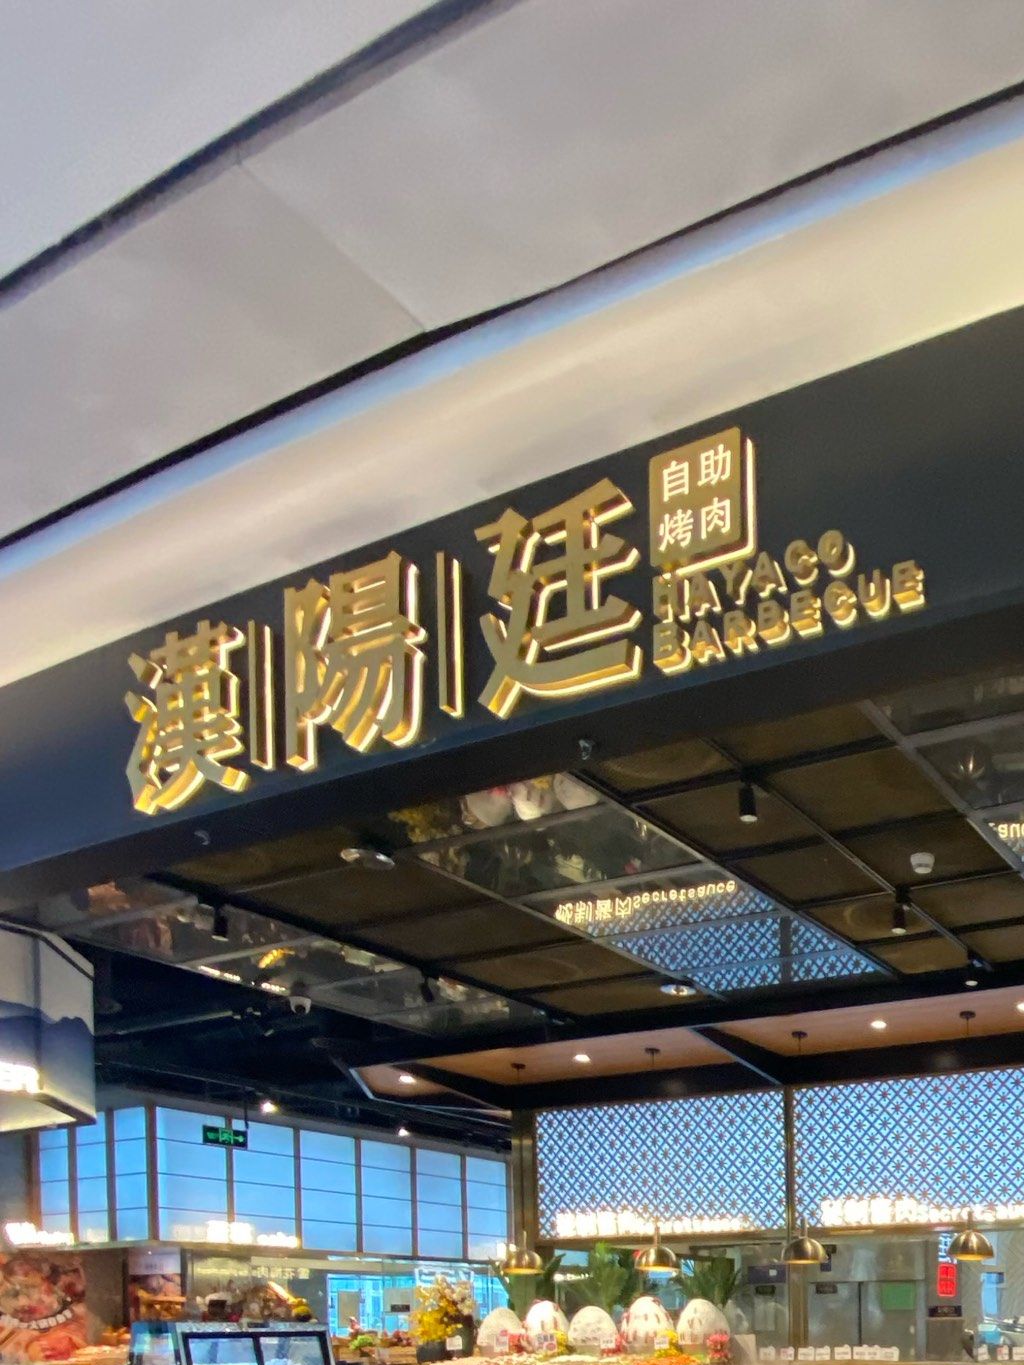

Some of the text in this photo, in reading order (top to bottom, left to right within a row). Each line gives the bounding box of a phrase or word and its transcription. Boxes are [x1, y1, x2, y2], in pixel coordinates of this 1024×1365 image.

[660, 443, 733, 503] 自助
[658, 497, 732, 552] 烤肉
[652, 559, 926, 677] BARBECUE
